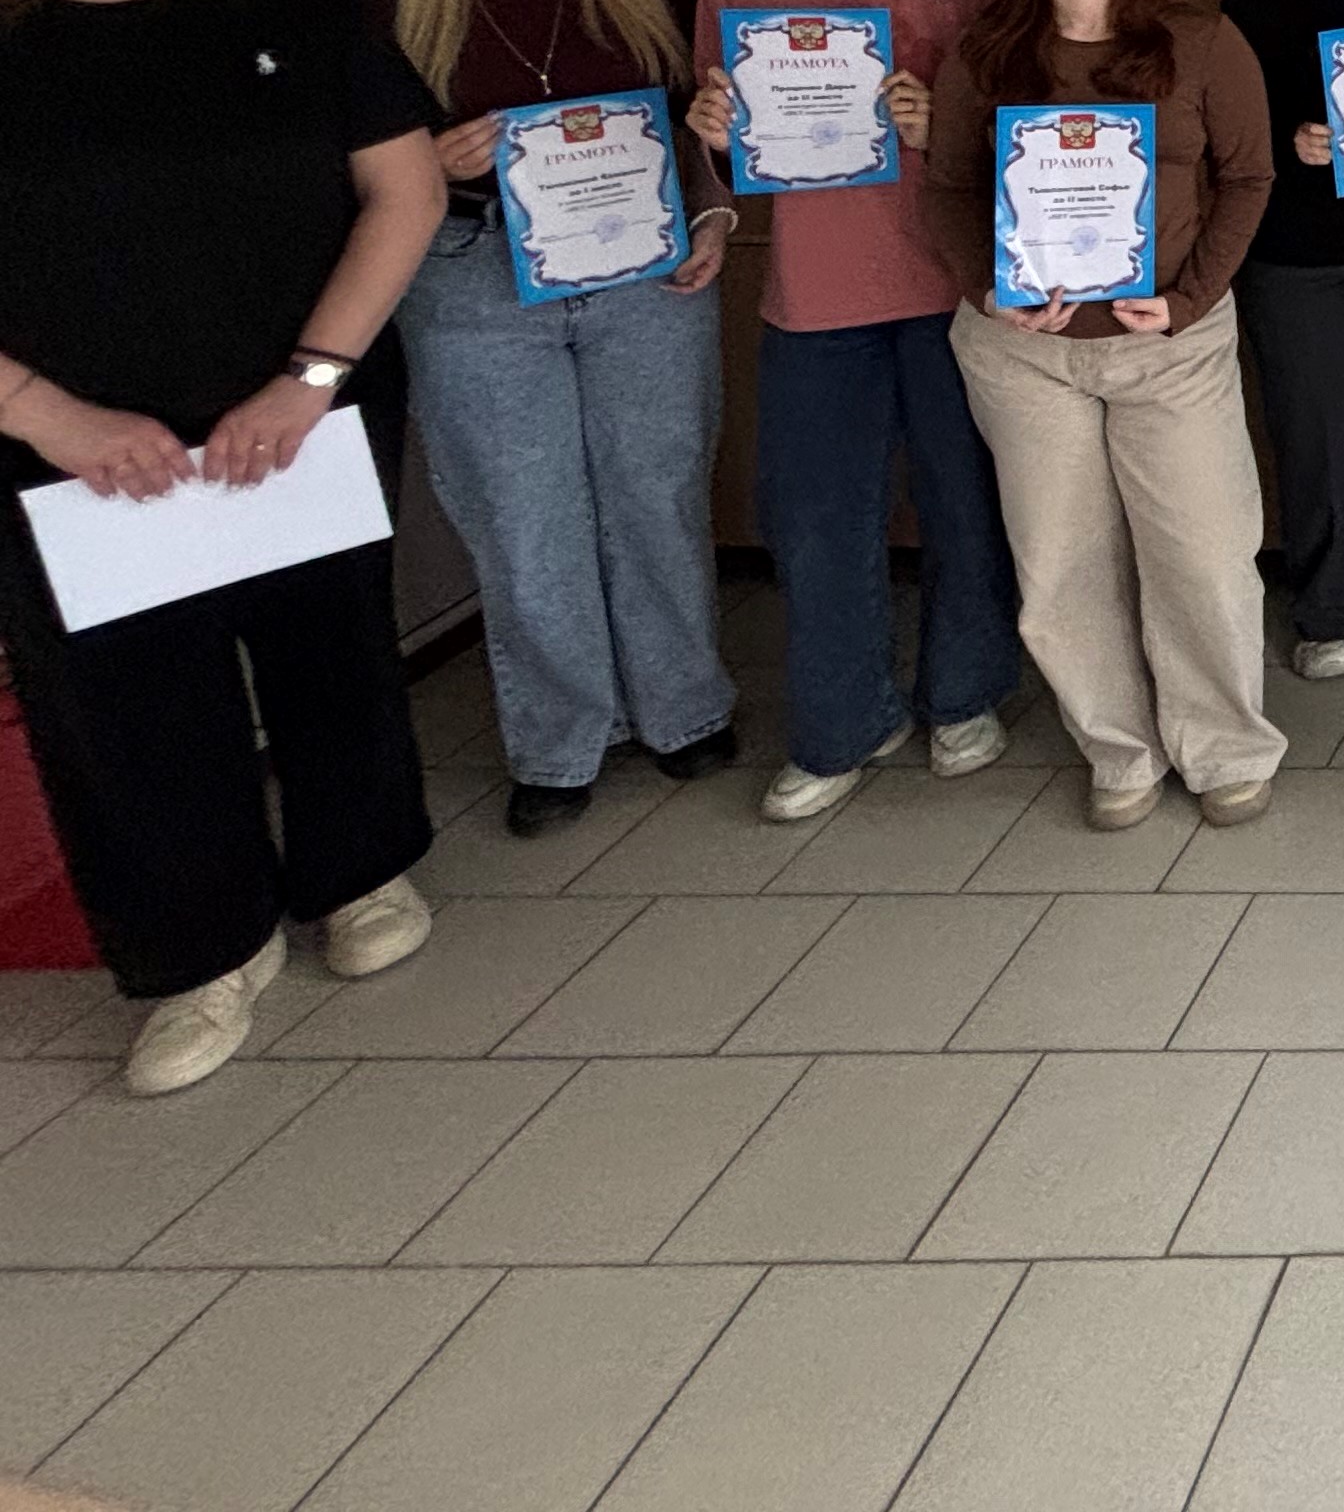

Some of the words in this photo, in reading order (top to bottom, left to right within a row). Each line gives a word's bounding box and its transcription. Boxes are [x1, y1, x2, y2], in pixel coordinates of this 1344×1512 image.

[769, 57, 849, 70] ГРАМОТА
[812, 93, 843, 101] место
[545, 144, 632, 165] ГРАМОТА
[1039, 157, 1114, 170] ГРАМОТА
